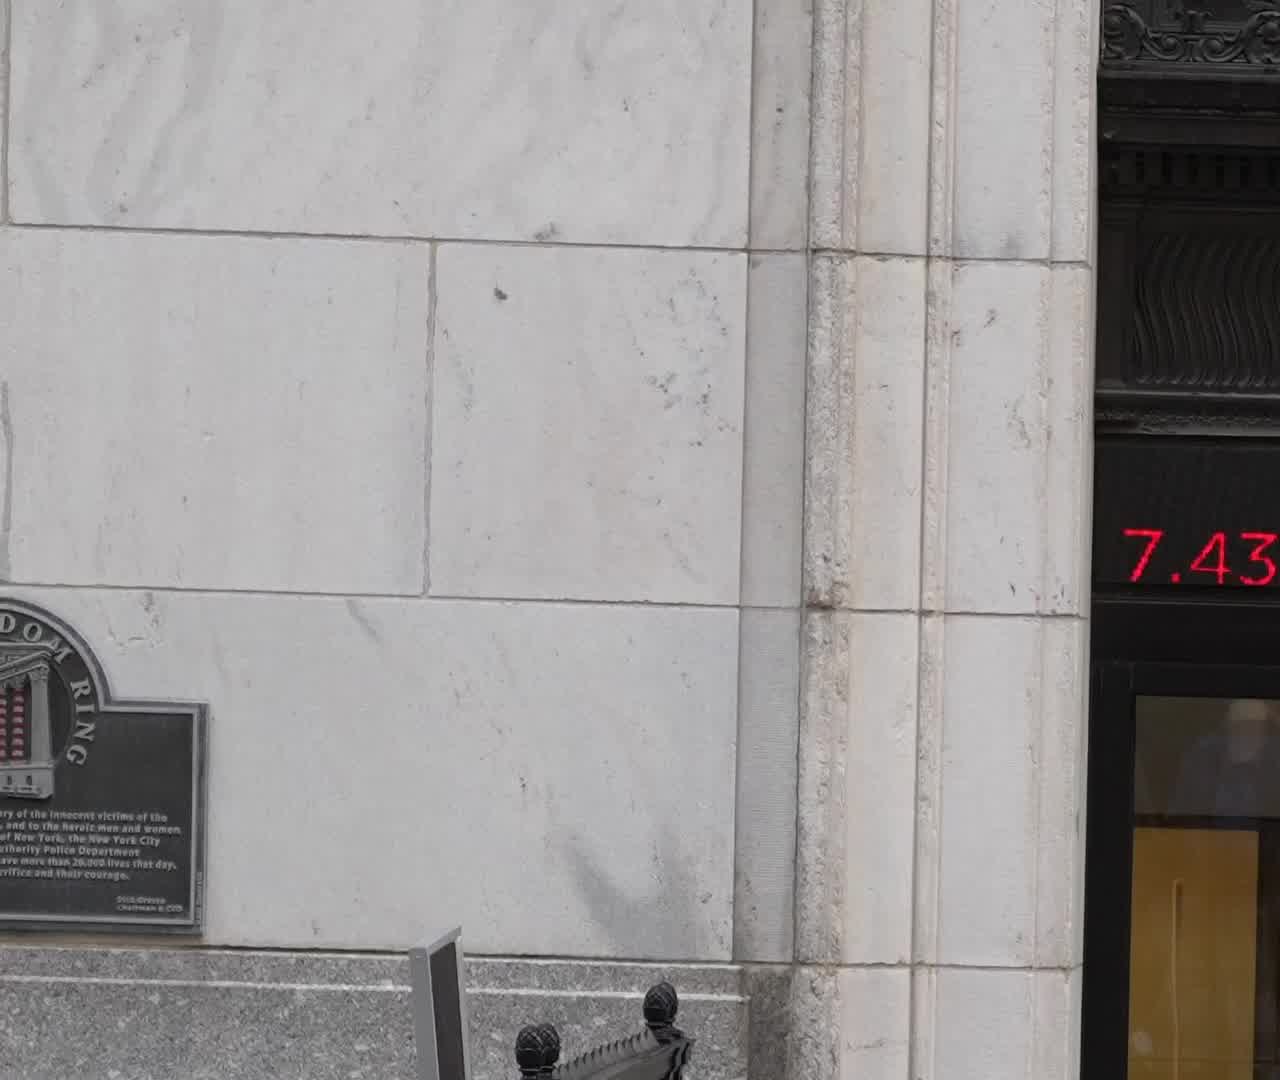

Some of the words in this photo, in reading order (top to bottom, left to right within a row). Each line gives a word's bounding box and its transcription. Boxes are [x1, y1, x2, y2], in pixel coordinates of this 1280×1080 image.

[1122, 527, 1280, 587] 7.43
[66, 677, 96, 766] RING
[16, 809, 28, 819] of
[30, 809, 47, 820] the
[136, 812, 147, 822] of
[150, 812, 168, 822] the
[28, 821, 40, 831] to
[42, 822, 60, 832] the
[122, 824, 141, 833] and
[113, 835, 137, 845] York
[140, 835, 160, 848] City
[44, 845, 76, 856] Police
[79, 847, 140, 857] Department
